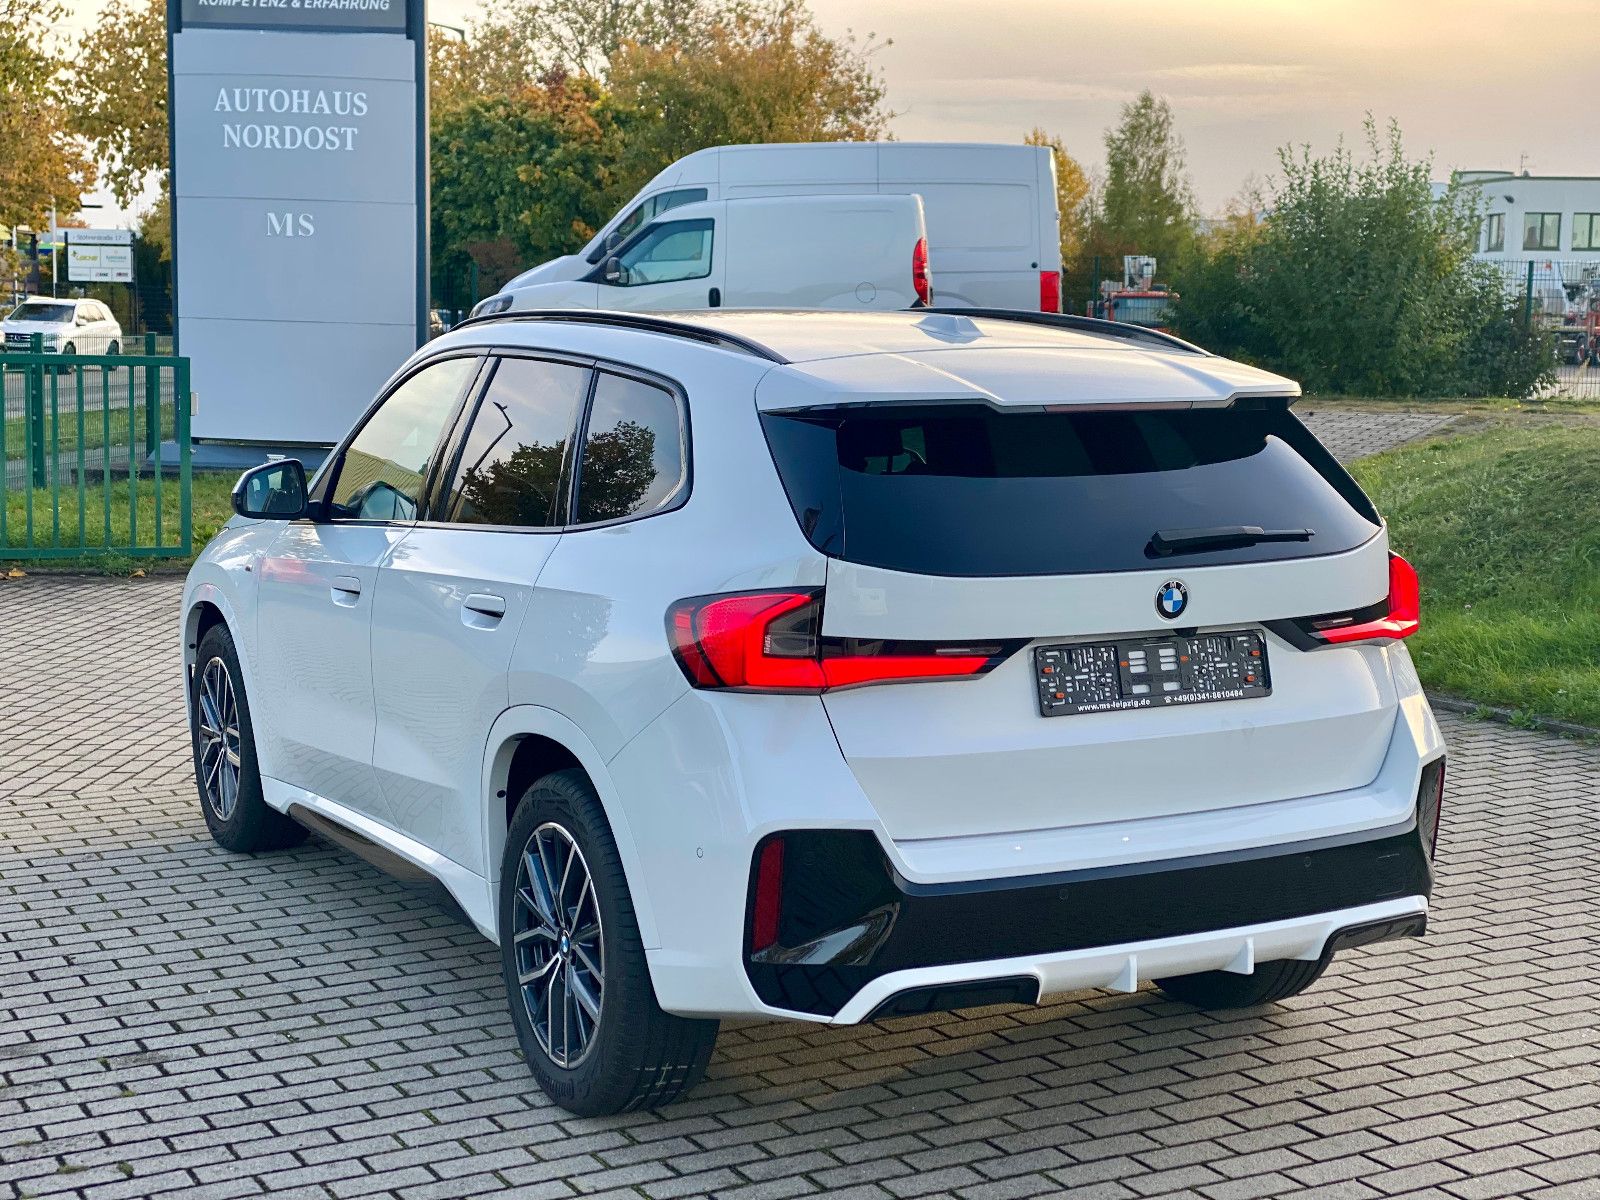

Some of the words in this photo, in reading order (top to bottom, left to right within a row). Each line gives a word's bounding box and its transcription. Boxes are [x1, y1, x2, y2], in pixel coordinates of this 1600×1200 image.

[304, 0, 390, 10] ERFAHRUNG
[214, 87, 368, 116] AUTOHAUS
[222, 124, 359, 151] NORDOST
[266, 212, 315, 237] MS
[1077, 698, 1151, 711] www.ms-leipzig.de
